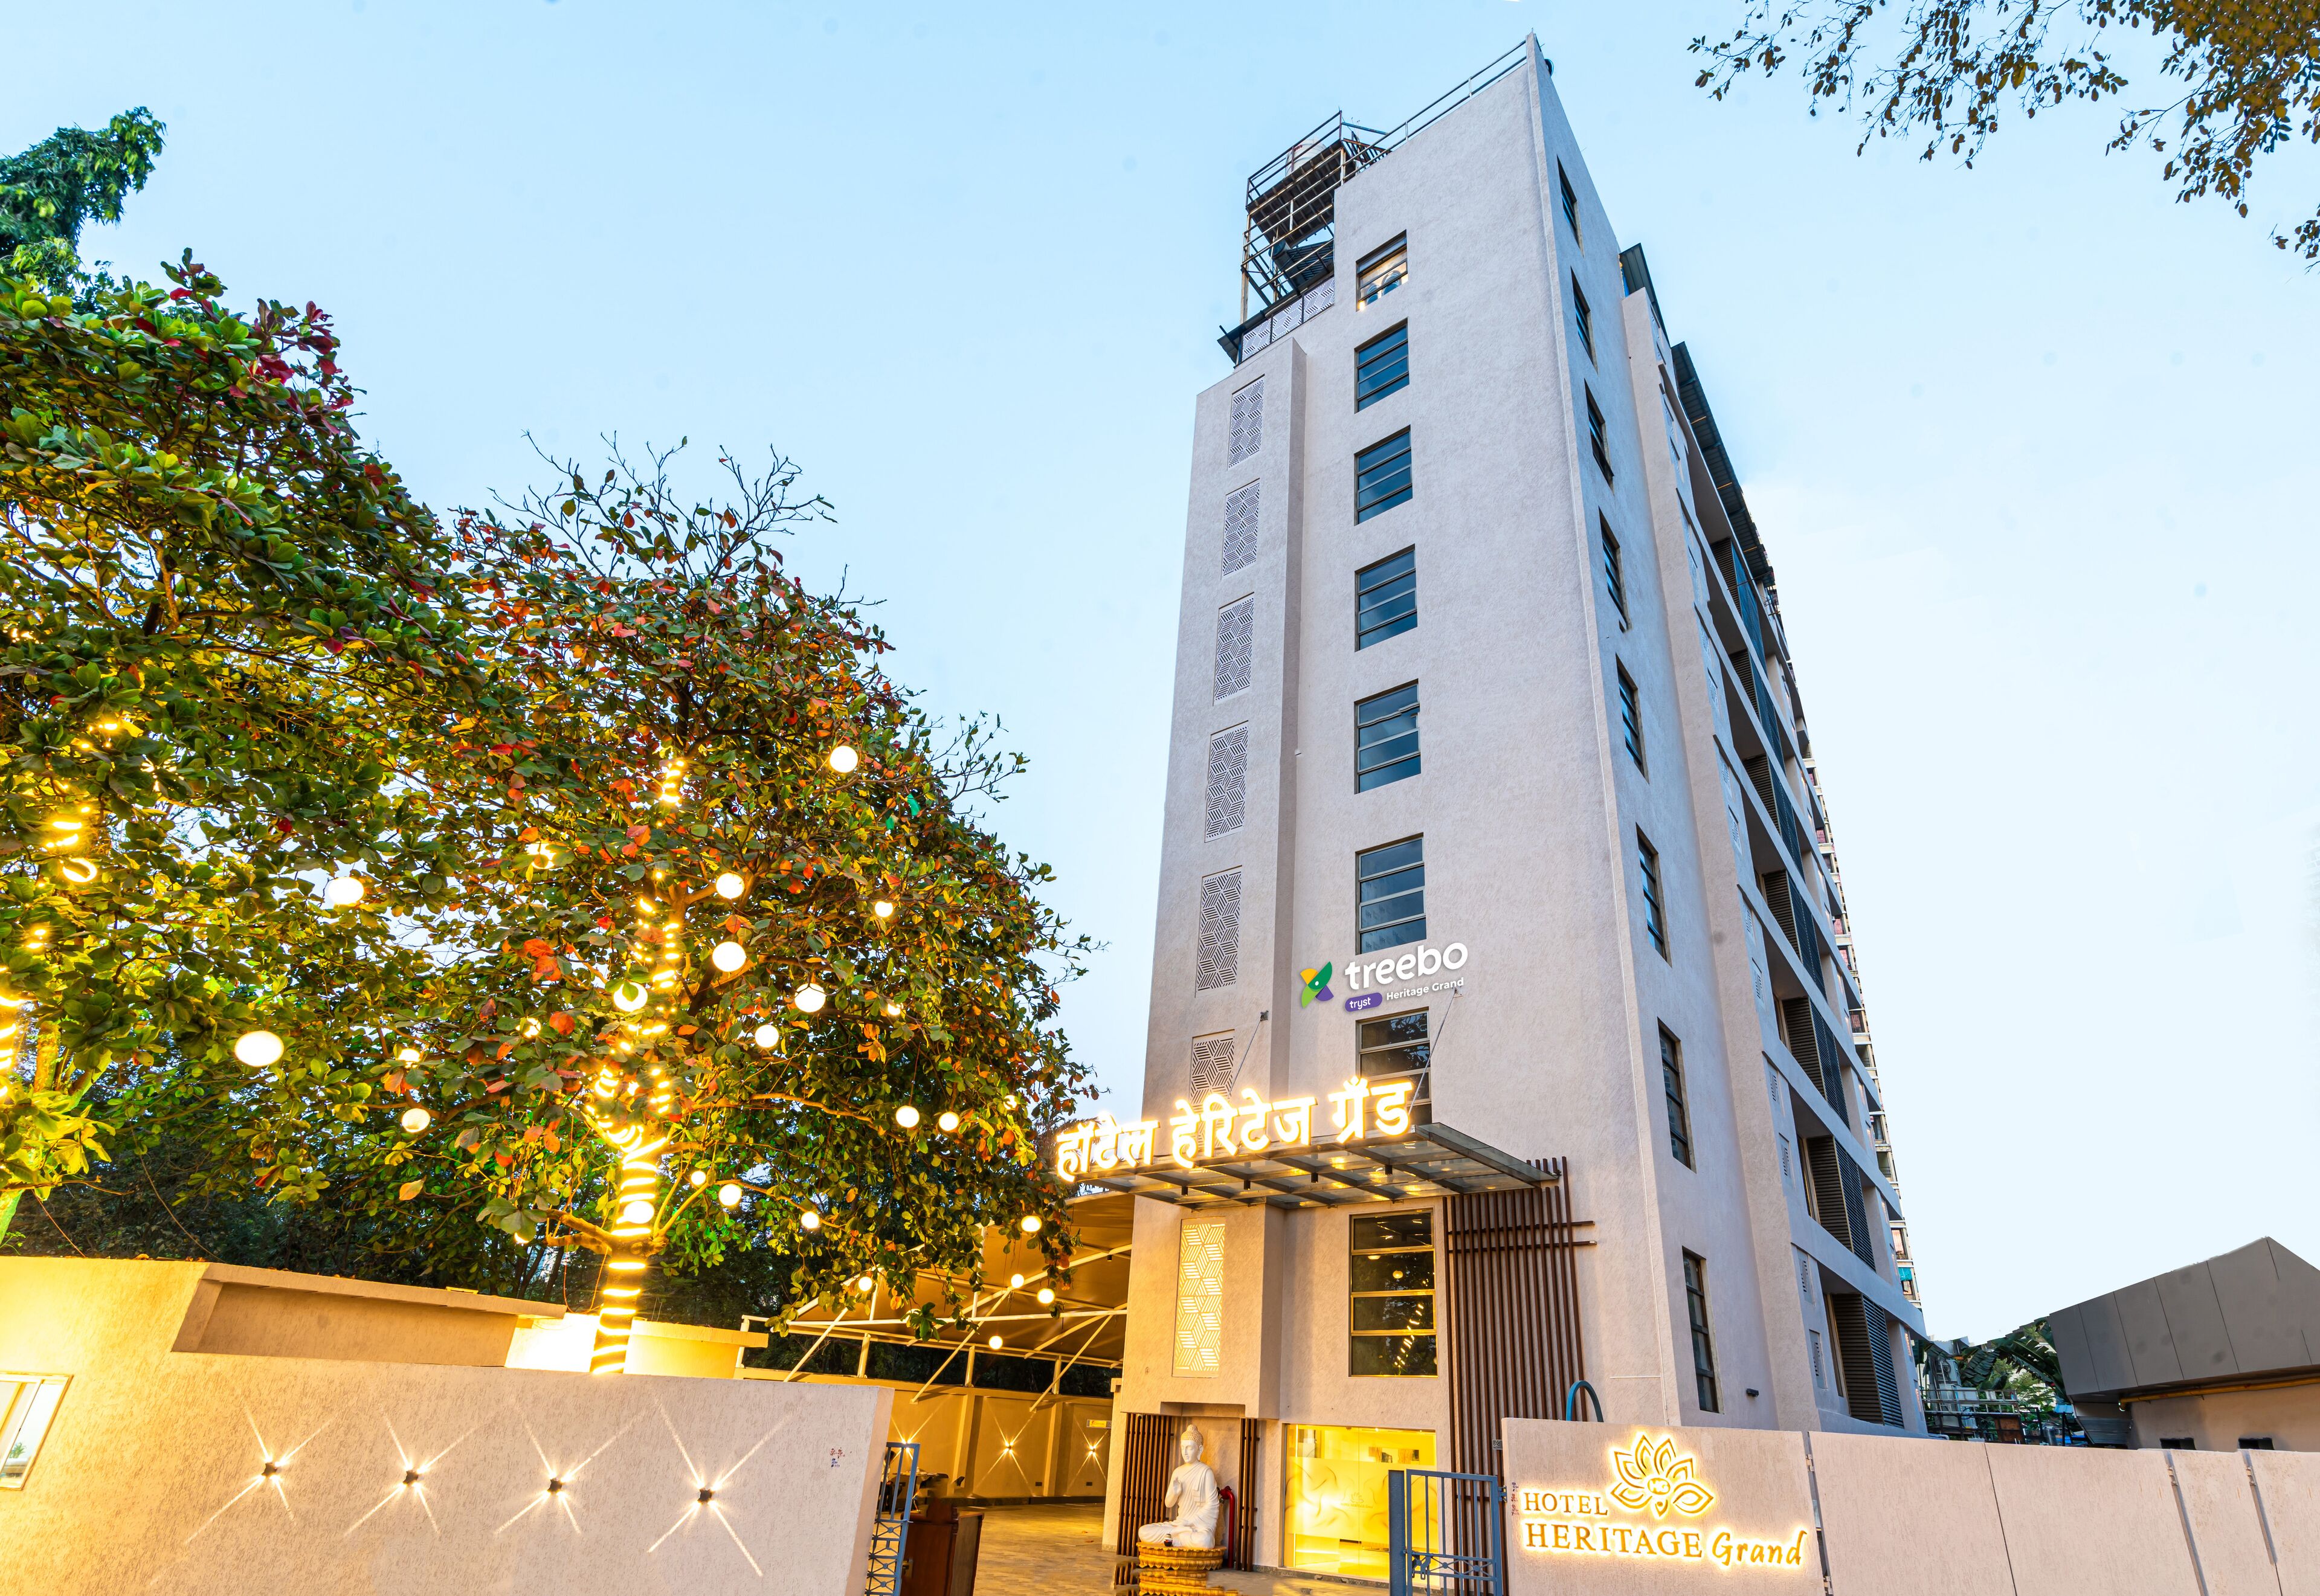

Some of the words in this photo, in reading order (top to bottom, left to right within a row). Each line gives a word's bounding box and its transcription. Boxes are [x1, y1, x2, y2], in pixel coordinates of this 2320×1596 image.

[1345, 942, 1468, 989] treebo
[1349, 997, 1371, 1009] tryst
[1386, 985, 1429, 1001] Heritage
[1432, 977, 1464, 991] Grand
[1169, 1087, 1318, 1169] हेरिटेज
[1523, 1492, 1608, 1515] HOTEL
[1526, 1522, 1703, 1557] HERITAGE
[1712, 1530, 1807, 1566] Grand
